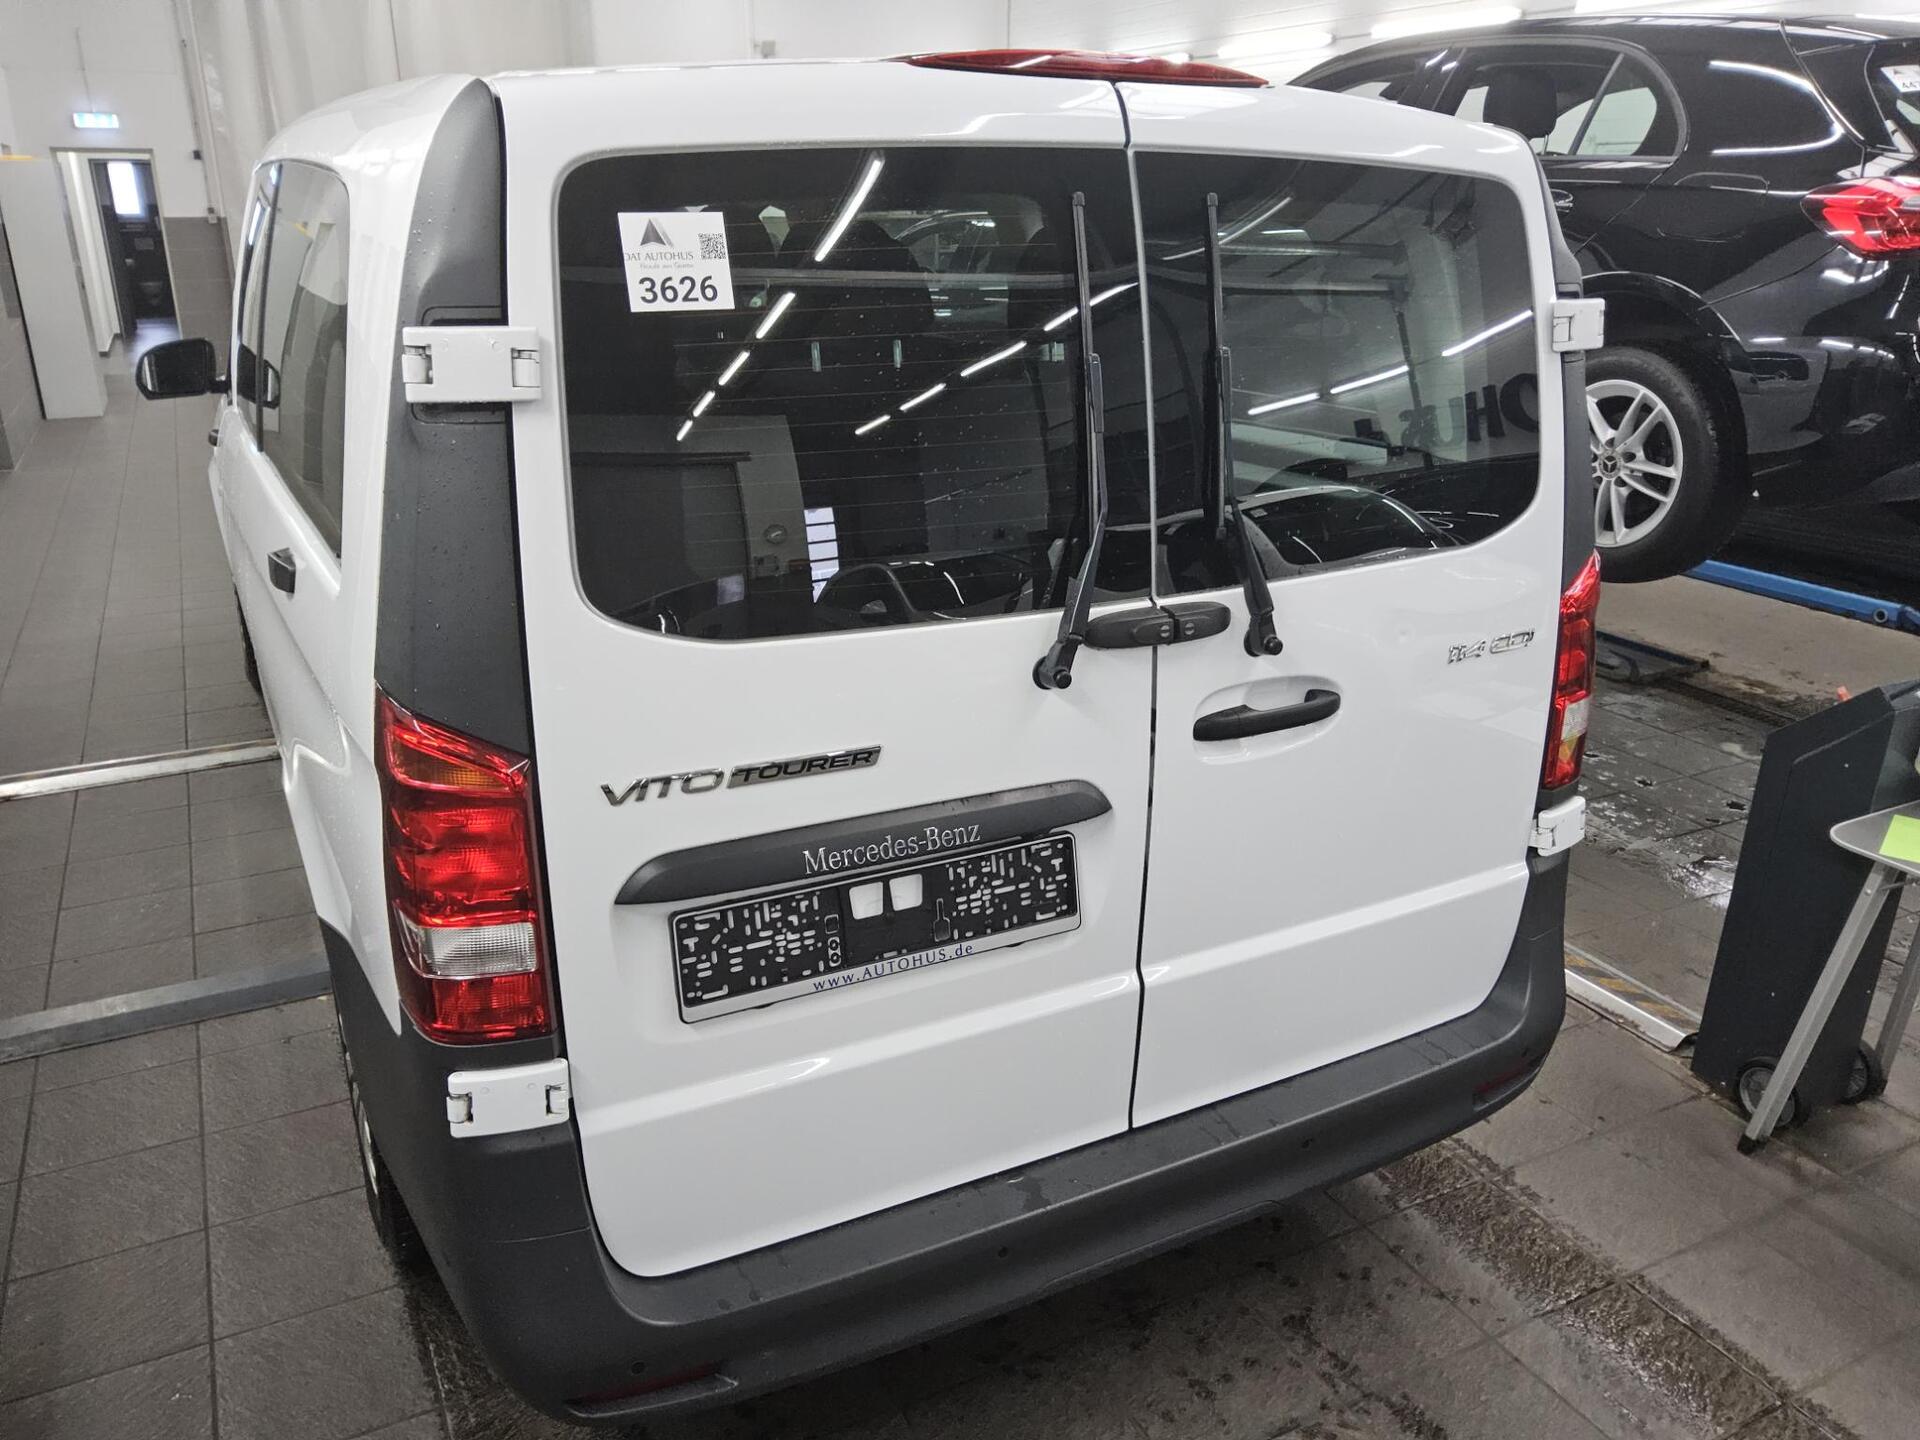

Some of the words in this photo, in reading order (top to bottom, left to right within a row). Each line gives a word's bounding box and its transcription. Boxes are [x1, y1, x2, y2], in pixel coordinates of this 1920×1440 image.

[644, 251, 694, 262] AUTOHUS
[638, 275, 718, 304] 3626
[600, 767, 725, 806] VITO
[731, 749, 874, 784] TOURER
[802, 823, 981, 875] Mercedes-Benz
[813, 943, 974, 991] www.AUTOHUS.de
